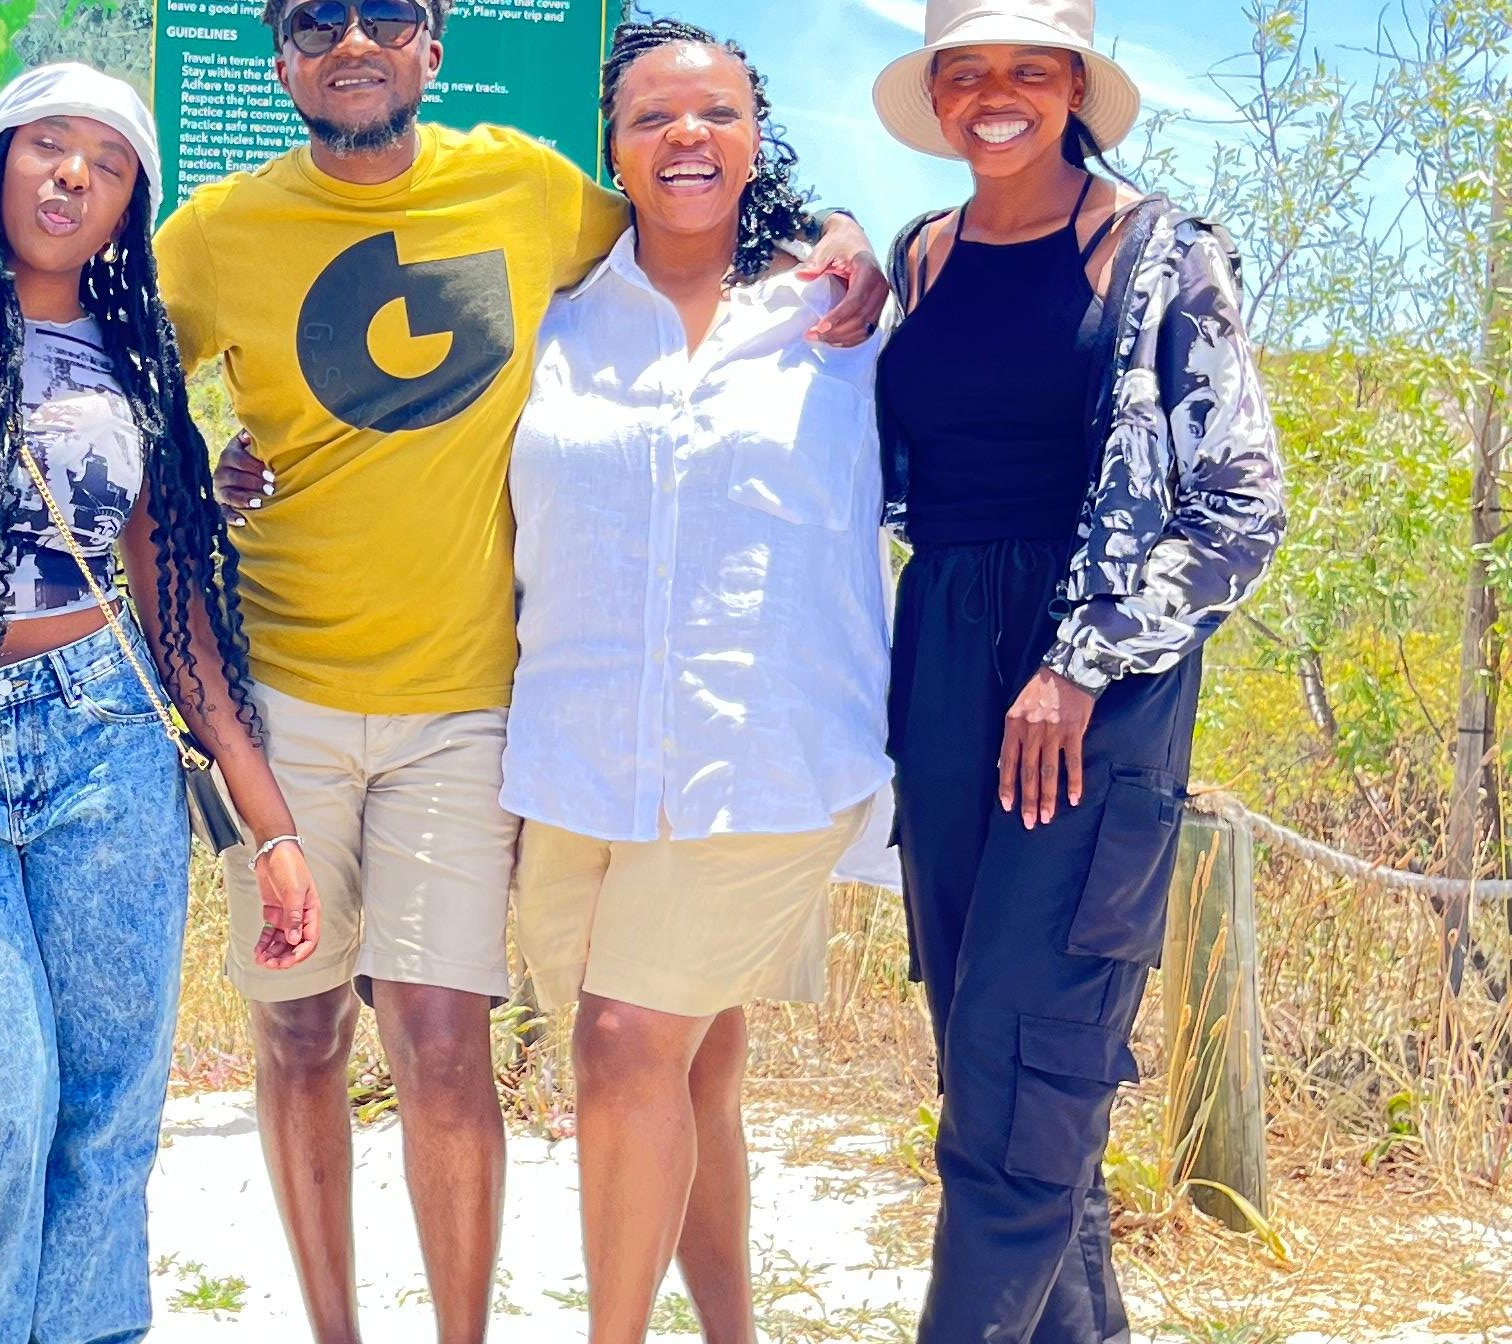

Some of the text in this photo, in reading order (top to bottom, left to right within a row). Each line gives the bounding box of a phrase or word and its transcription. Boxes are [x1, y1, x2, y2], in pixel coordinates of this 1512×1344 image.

[168, 0, 197, 12] leave
[199, 3, 206, 12] a
[208, 3, 238, 15] good
[536, 0, 570, 10] covers
[473, 6, 497, 18] Plan
[498, 10, 523, 21] your
[524, 10, 542, 23] trip
[543, 12, 565, 23] and
[167, 26, 238, 41] GUIDELINES
[182, 52, 215, 65] Travel
[217, 53, 227, 65] in
[229, 55, 265, 67] terrain
[181, 65, 206, 80] Stay
[207, 67, 241, 79] within
[243, 68, 261, 80] the
[451, 82, 474, 93] new
[476, 82, 509, 95] tracks.
[181, 78, 222, 91] Adhere
[224, 82, 236, 92] to
[237, 83, 271, 95] speed
[181, 91, 225, 106] Respect
[226, 94, 244, 105] the
[247, 96, 273, 107] local
[181, 104, 223, 117] Practice
[225, 107, 248, 119] safe
[250, 111, 289, 123] convoy
[180, 118, 223, 131] Practice
[225, 121, 248, 132] safe
[250, 124, 296, 136] recovery
[179, 132, 209, 144] stuck
[210, 132, 255, 146] vehicles
[256, 134, 283, 147] have
[179, 144, 221, 157] Reduce
[222, 147, 244, 160] tyre
[178, 159, 223, 171] traction.
